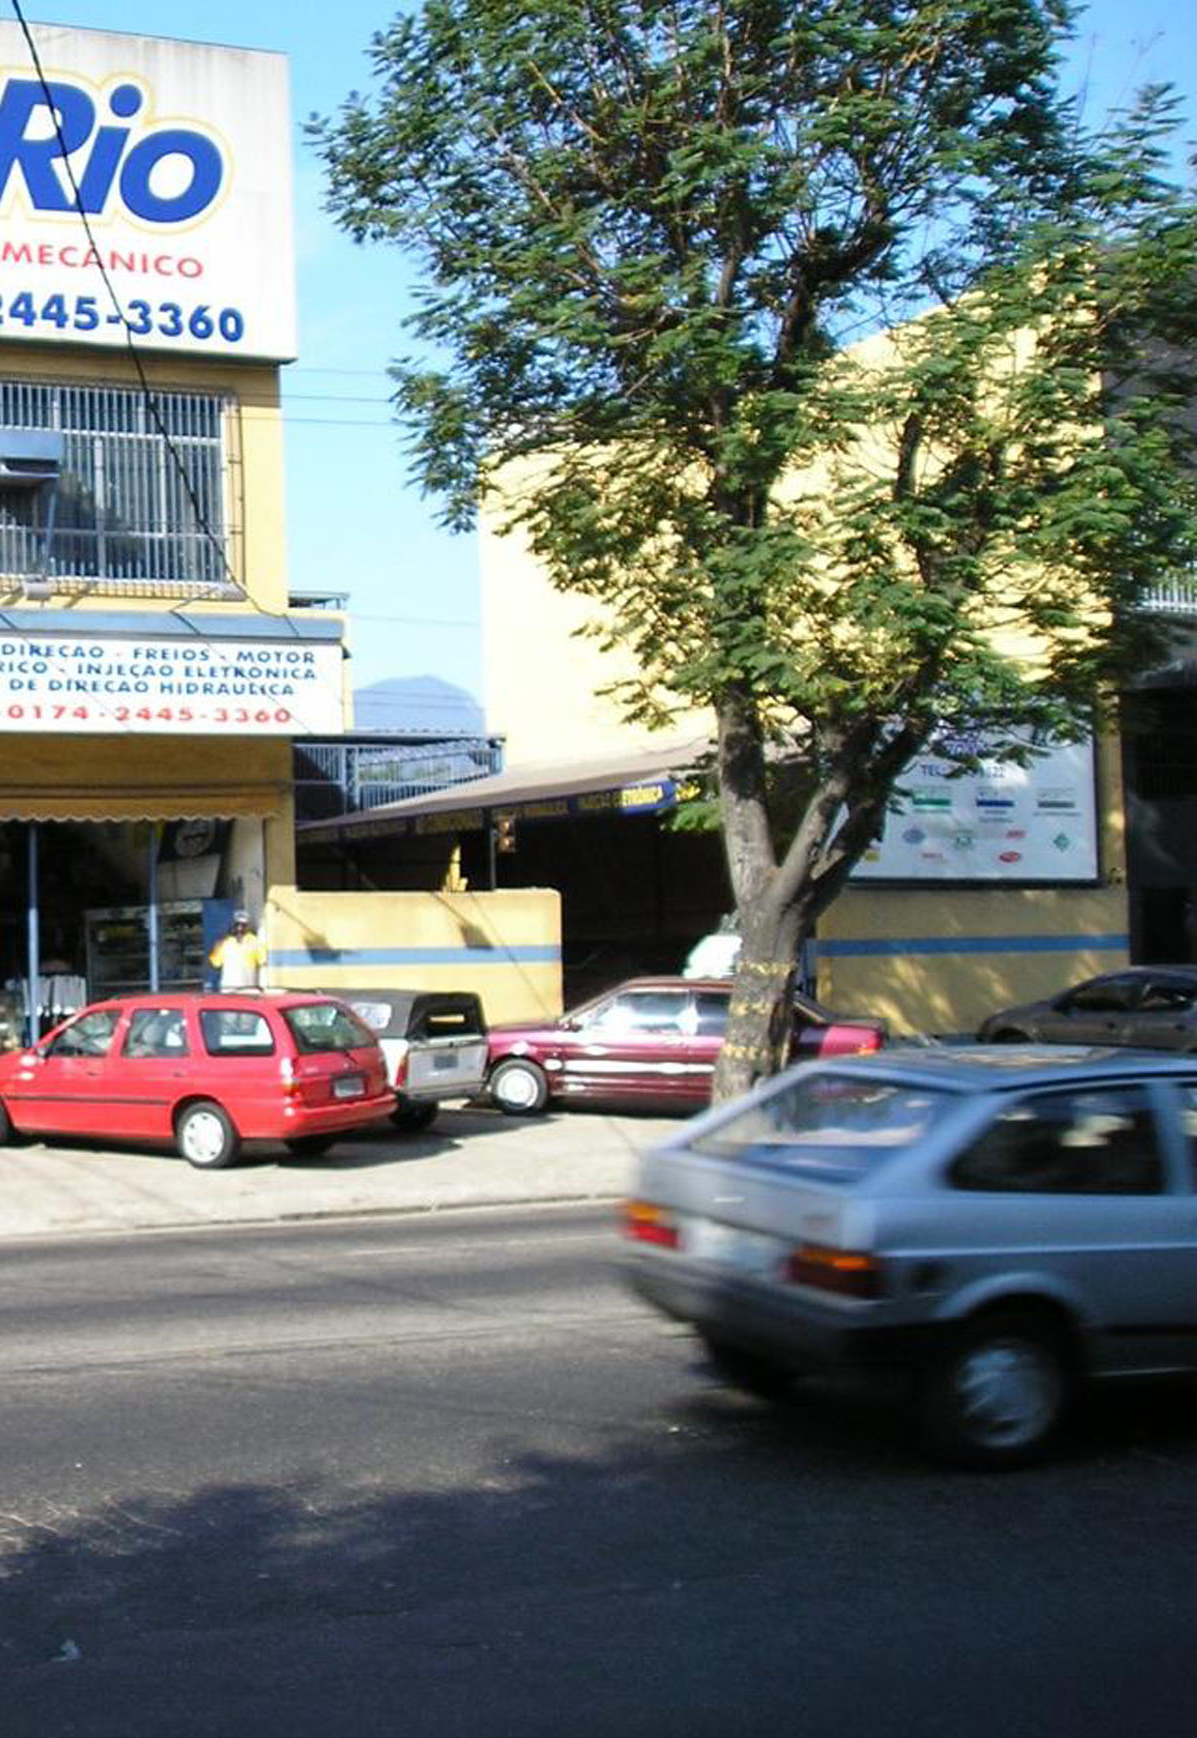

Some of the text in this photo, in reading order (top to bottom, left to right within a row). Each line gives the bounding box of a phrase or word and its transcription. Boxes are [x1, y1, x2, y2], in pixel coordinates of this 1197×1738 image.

[133, 647, 211, 661] FREIOS
[236, 650, 316, 665] MOTOR
[9, 679, 38, 691] DE
[115, 706, 292, 724] 2445-3360
